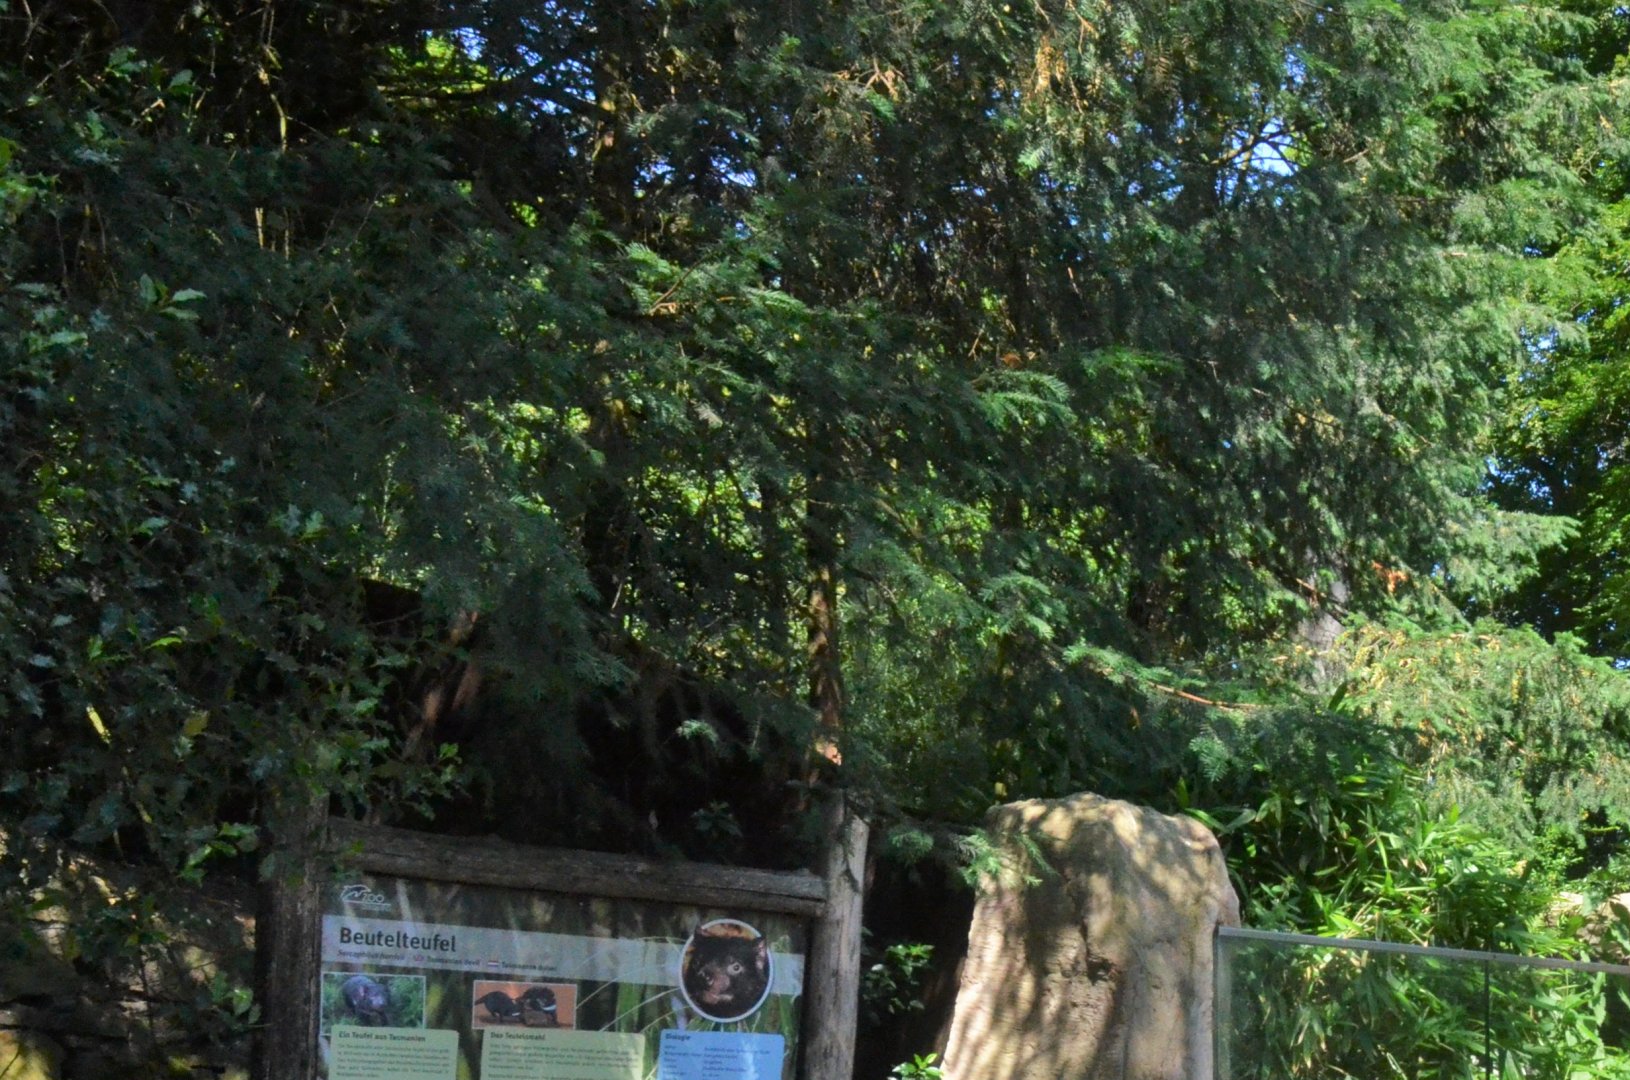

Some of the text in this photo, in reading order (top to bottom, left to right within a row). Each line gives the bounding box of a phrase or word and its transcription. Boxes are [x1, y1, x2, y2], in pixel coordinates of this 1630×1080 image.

[340, 926, 456, 952] Beutelteufel
[352, 1031, 373, 1040] Teufel
[389, 1033, 426, 1042] Tasmanien
